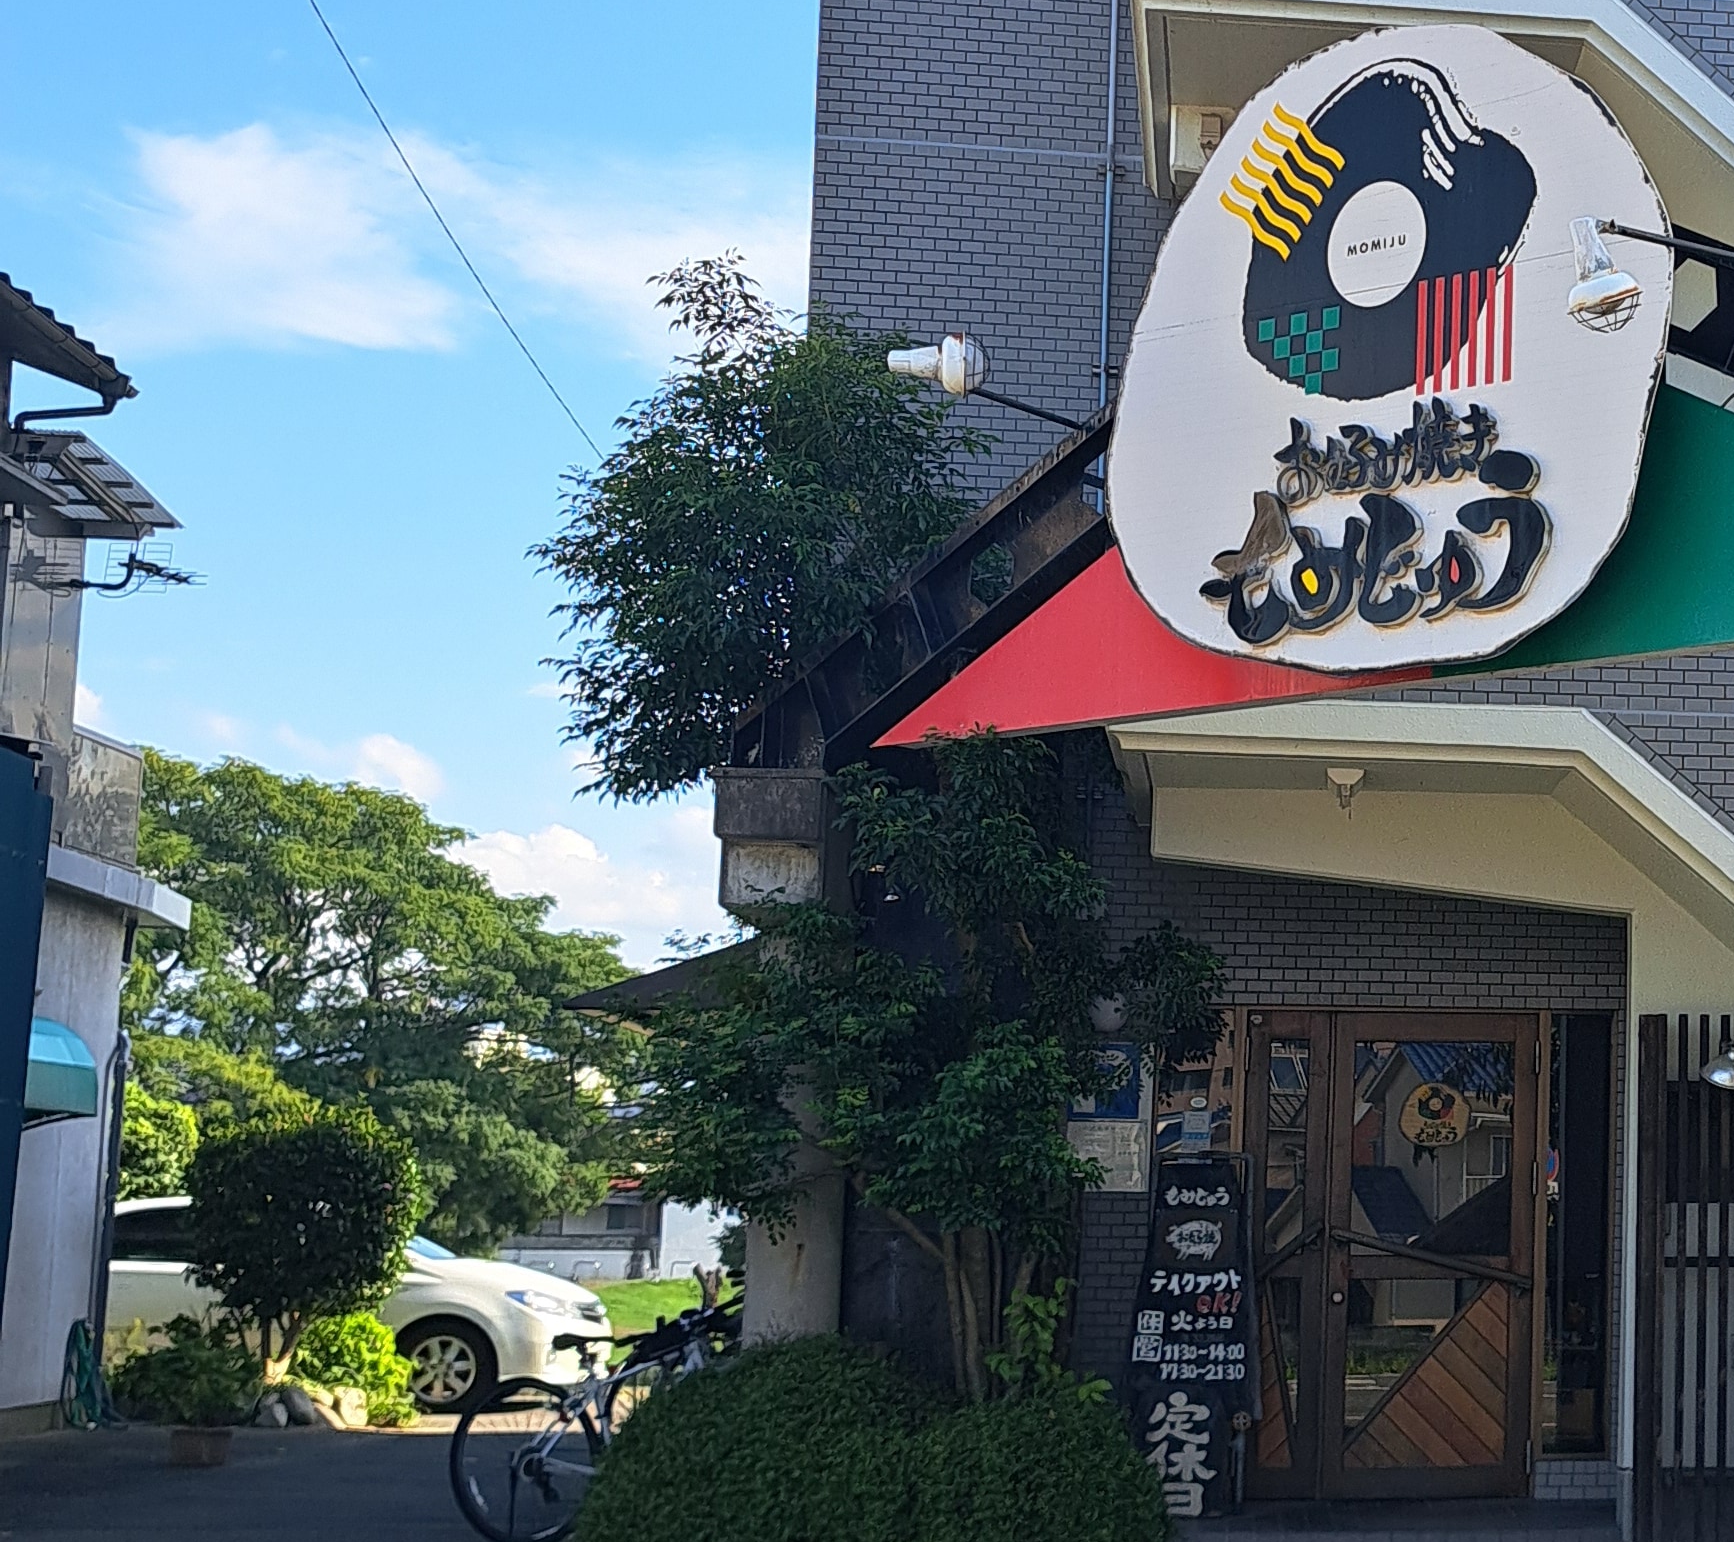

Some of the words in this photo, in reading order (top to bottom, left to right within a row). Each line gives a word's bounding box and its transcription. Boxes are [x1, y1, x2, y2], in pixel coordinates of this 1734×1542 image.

[1347, 234, 1406, 257] MOMIJU
[1273, 396, 1500, 507] お好み焼き
[1150, 1268, 1242, 1296] テイクアウト
[1196, 1291, 1242, 1315] OK!
[1171, 1310, 1234, 1332] 火よう日
[1145, 1391, 1218, 1516] 定休日
